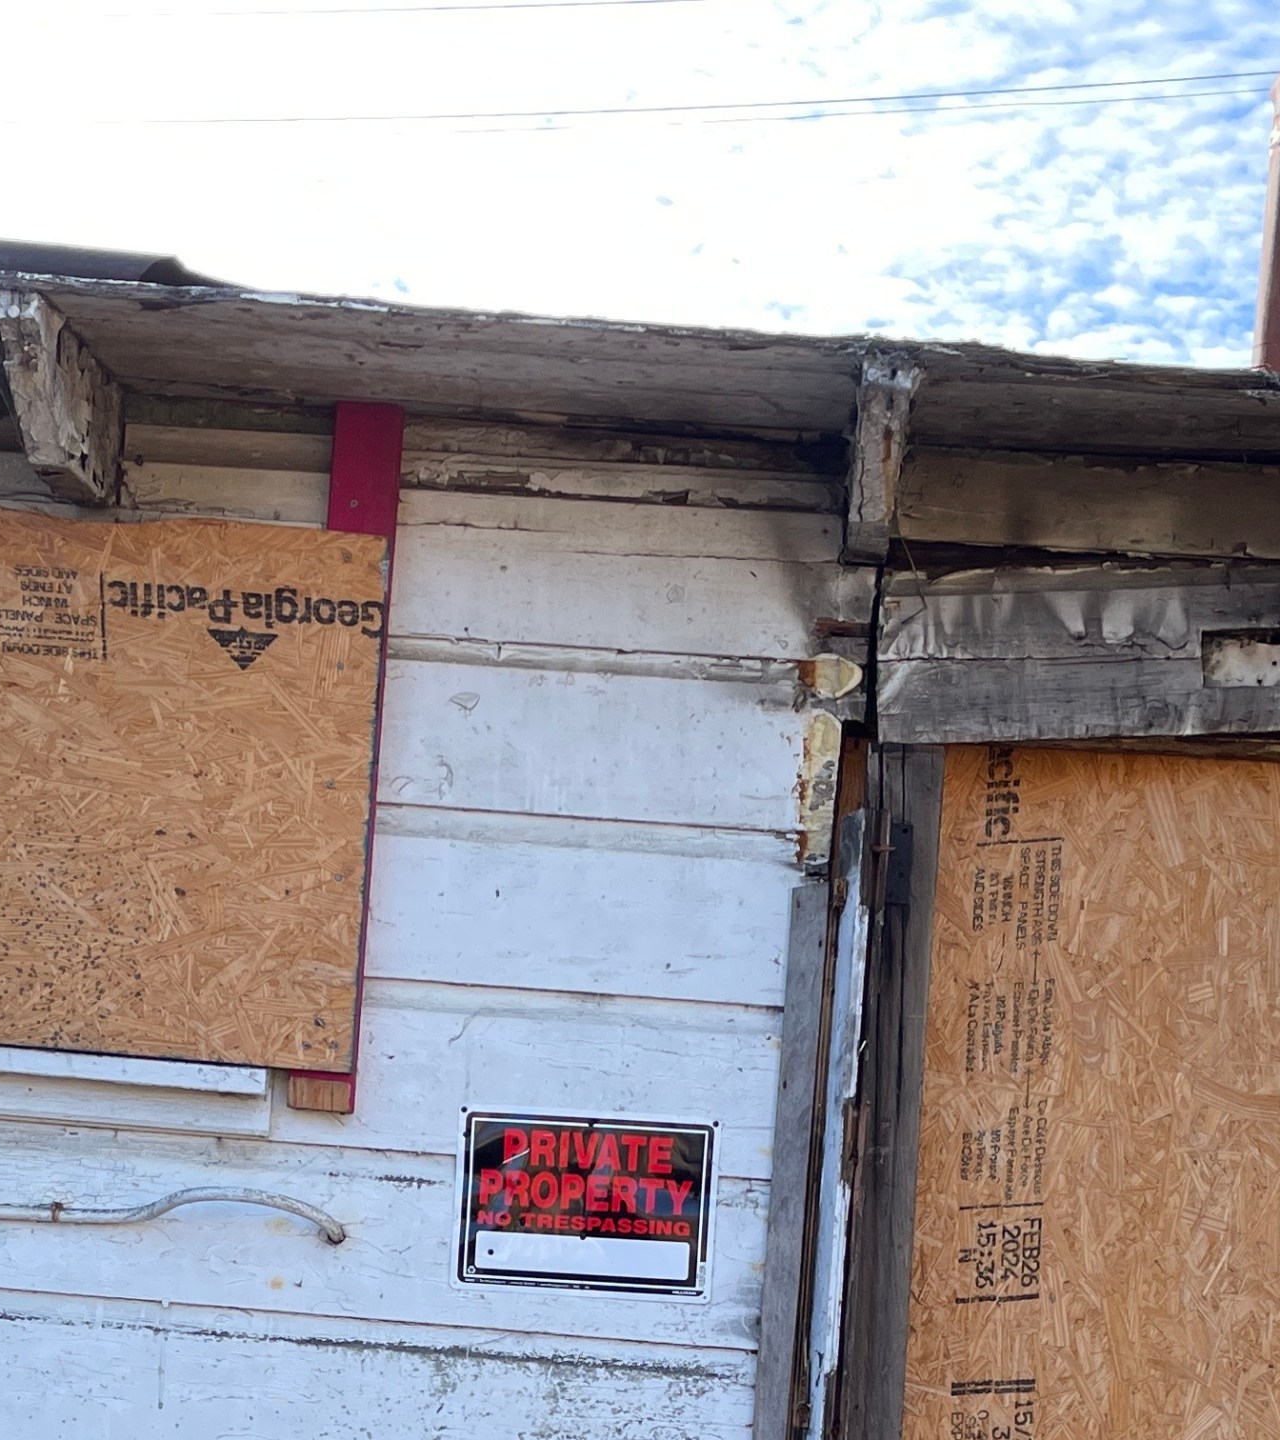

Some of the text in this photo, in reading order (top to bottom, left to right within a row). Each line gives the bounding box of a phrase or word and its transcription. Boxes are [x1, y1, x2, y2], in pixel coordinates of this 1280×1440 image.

[55, 613, 97, 625] SPACE
[974, 867, 985, 894] AND
[1016, 847, 1030, 950] SPACE PANELS
[1049, 875, 1060, 902] SIDE
[503, 1127, 674, 1174] PRIVATE
[479, 1169, 693, 1215] PROPERTY
[477, 1210, 691, 1236] NO TRESPASSING
[958, 1249, 977, 1264] N
[975, 1221, 996, 1289] 15:36
[1001, 1225, 1021, 1281] 2024
[1021, 1218, 1042, 1287] FEB26
